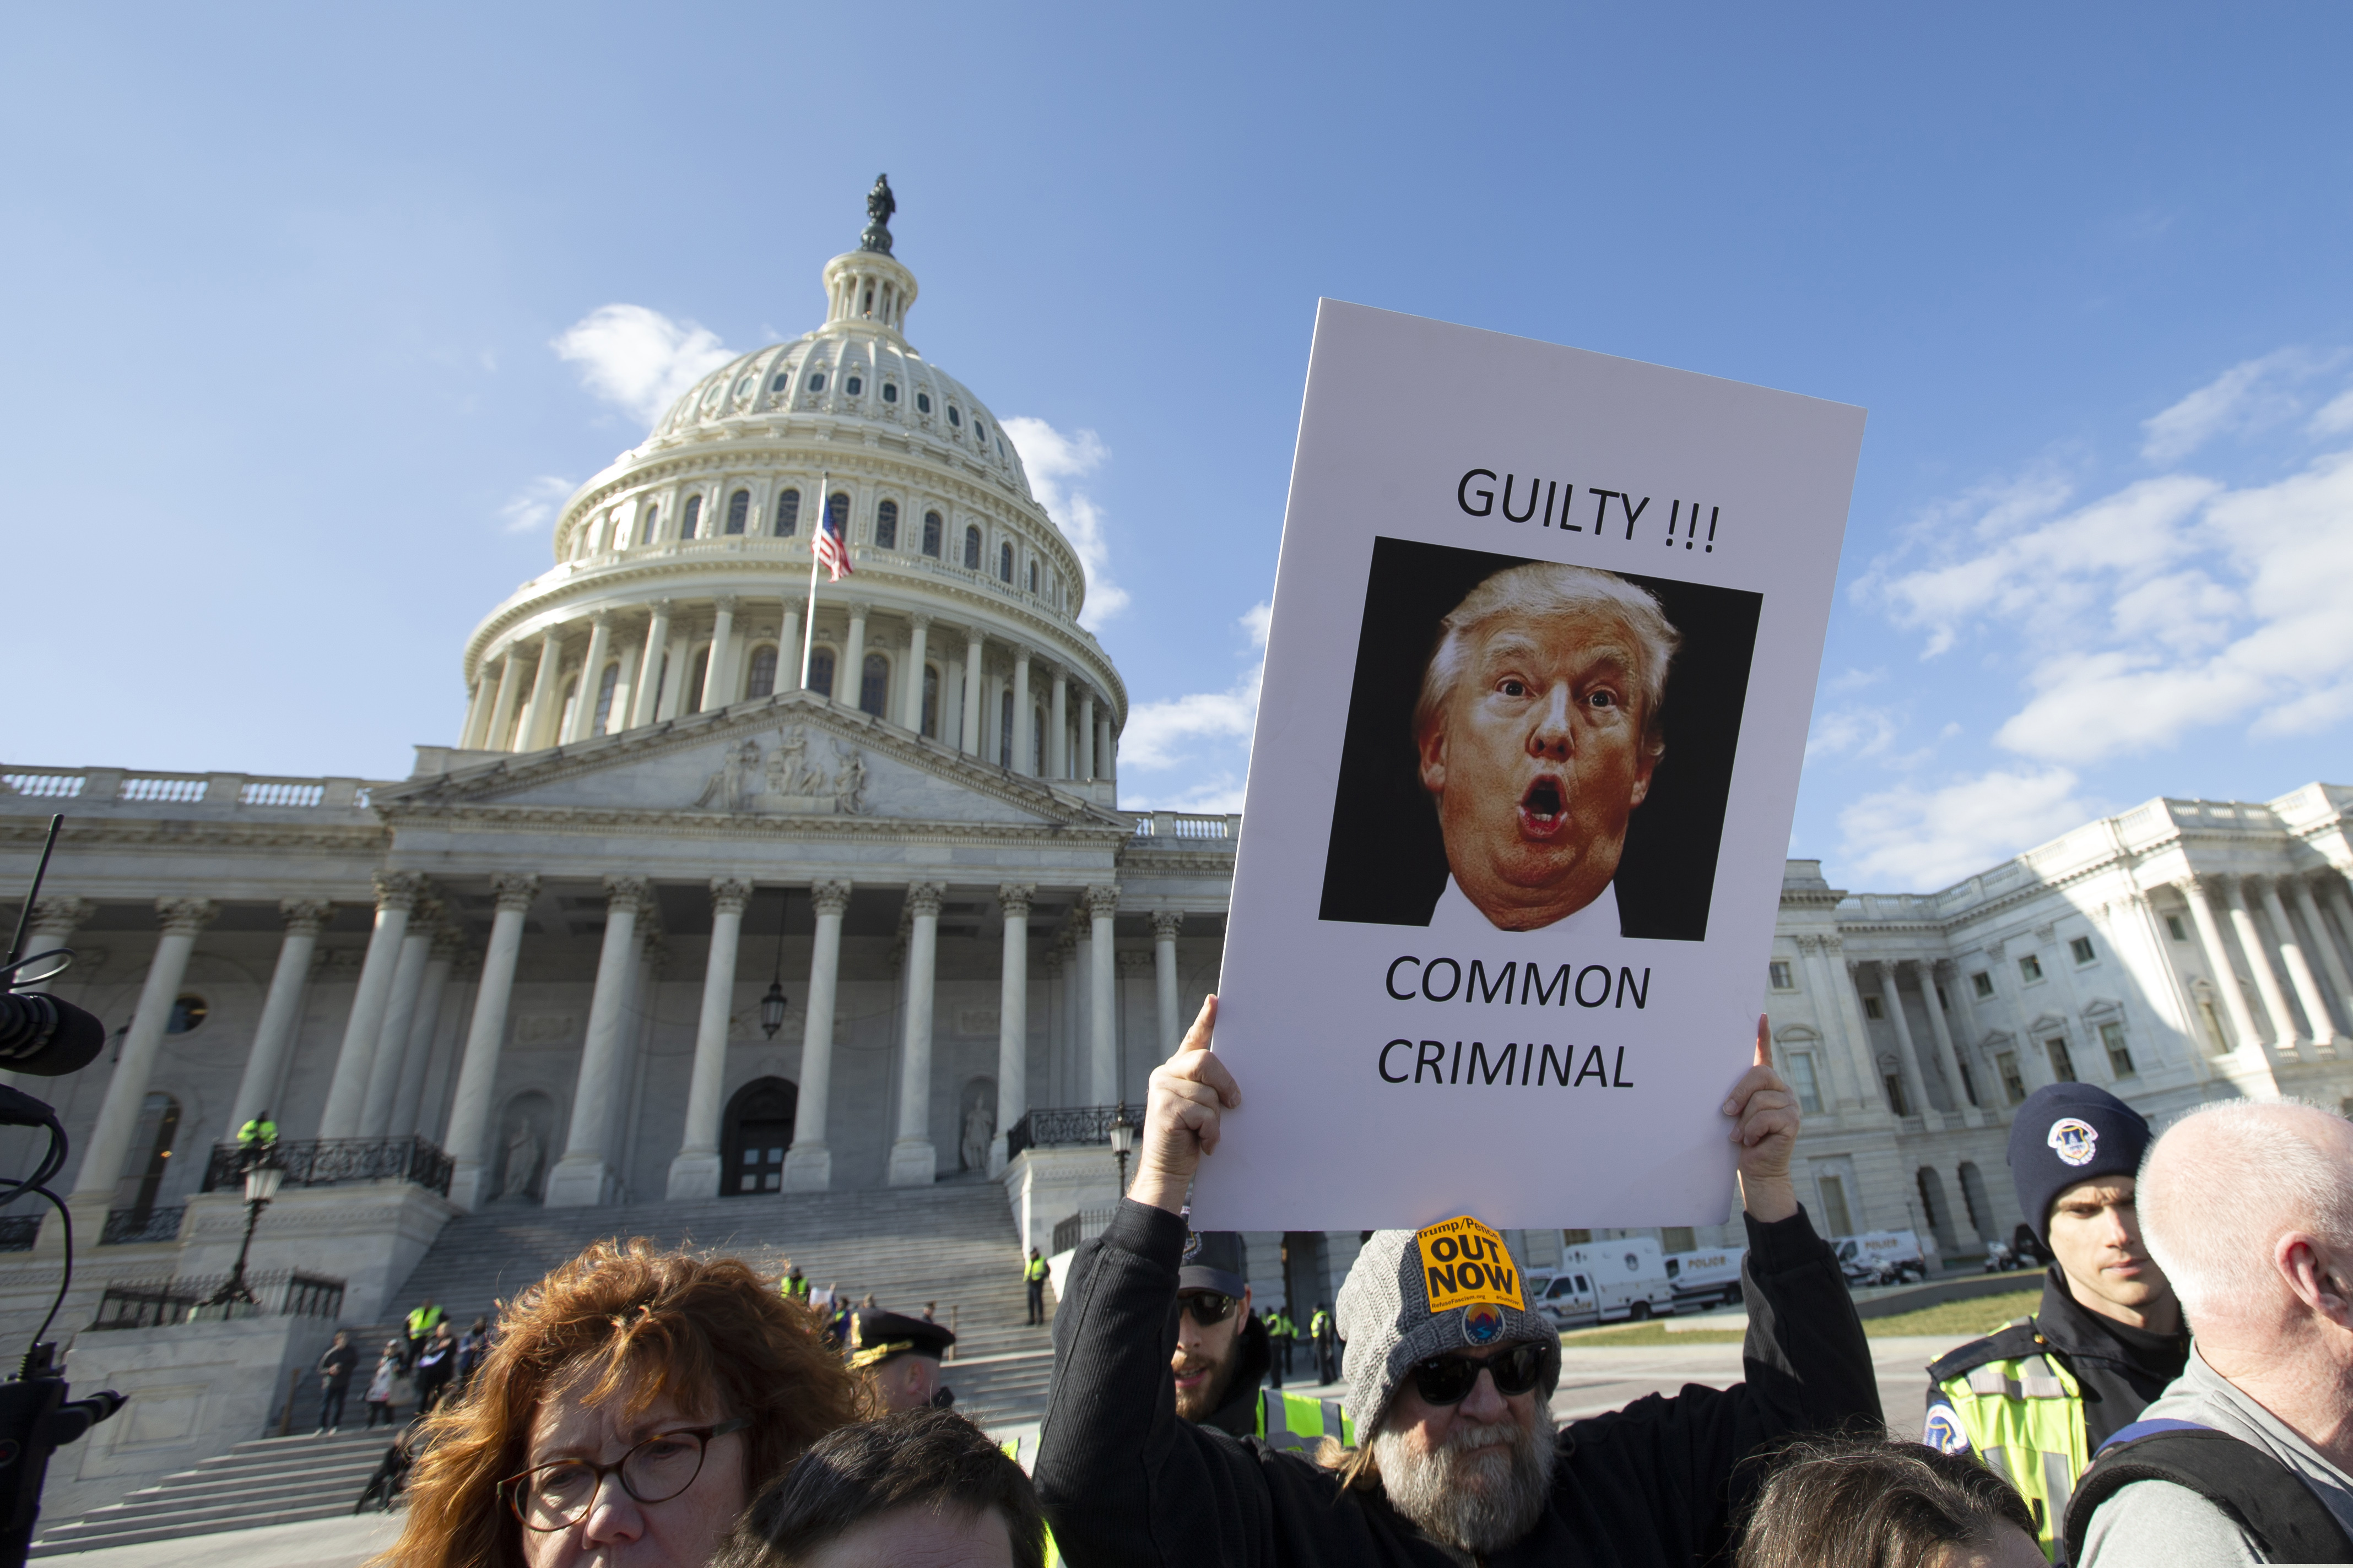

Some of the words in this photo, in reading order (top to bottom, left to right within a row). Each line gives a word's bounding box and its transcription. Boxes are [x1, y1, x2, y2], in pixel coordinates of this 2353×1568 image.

[1457, 468, 1650, 540] GUILTY
[1665, 500, 1719, 554] !!!
[1386, 955, 1651, 1009] COMMON
[1378, 1039, 1634, 1088] CRIMINAL
[1417, 1218, 1500, 1241] Trump/Pence
[1430, 1234, 1500, 1264] OUT
[1688, 1256, 1726, 1269] POLICE
[1428, 1262, 1513, 1298] NOW
[1431, 1294, 1486, 1309] RefuseFascism.org
[1467, 1330, 1478, 1343] LIFE
[1487, 1326, 1502, 1343] GOOD
